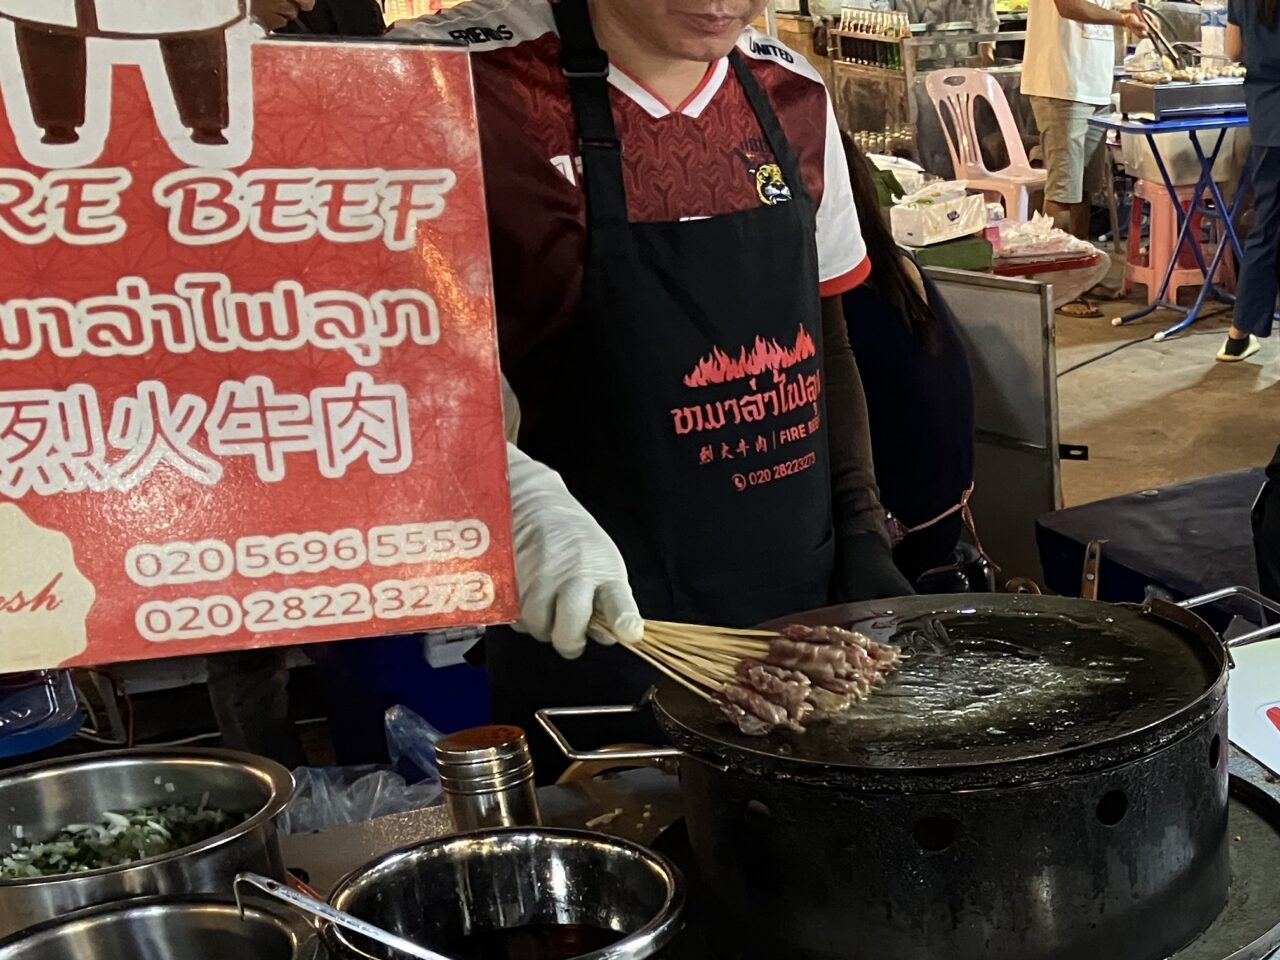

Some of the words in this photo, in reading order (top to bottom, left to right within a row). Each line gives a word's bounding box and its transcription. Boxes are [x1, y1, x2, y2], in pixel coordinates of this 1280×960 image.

[749, 36, 794, 63] UNITED
[152, 168, 456, 251] BEEF
[0, 371, 412, 498] 烈火牛肉
[780, 424, 806, 444] FIRE
[750, 468, 772, 485] 020
[125, 540, 232, 590] 020
[235, 529, 366, 578] 5696
[367, 520, 489, 566] 5559
[136, 592, 249, 642] 020
[242, 584, 374, 633] 2822
[373, 571, 495, 624] 3273
